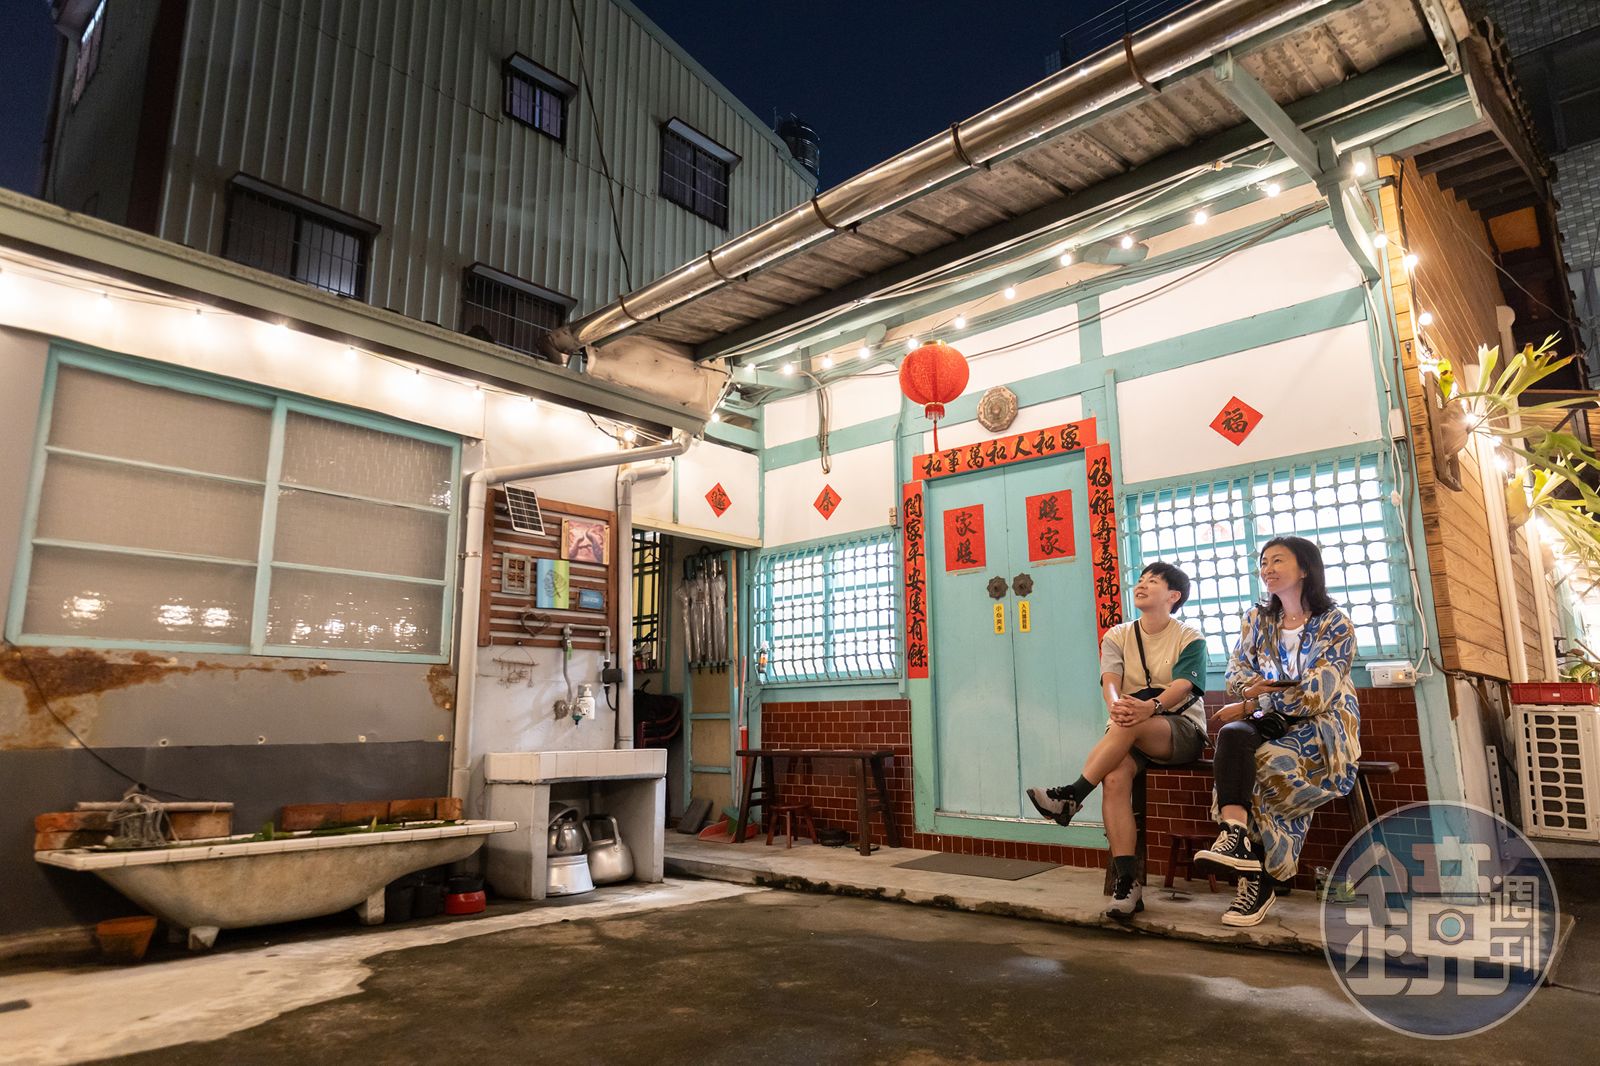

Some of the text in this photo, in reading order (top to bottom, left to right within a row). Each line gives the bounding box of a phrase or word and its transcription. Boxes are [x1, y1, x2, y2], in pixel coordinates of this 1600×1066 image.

[1221, 407, 1249, 433] 福
[1088, 456, 1123, 650] 福祿壽喜瑞滿
